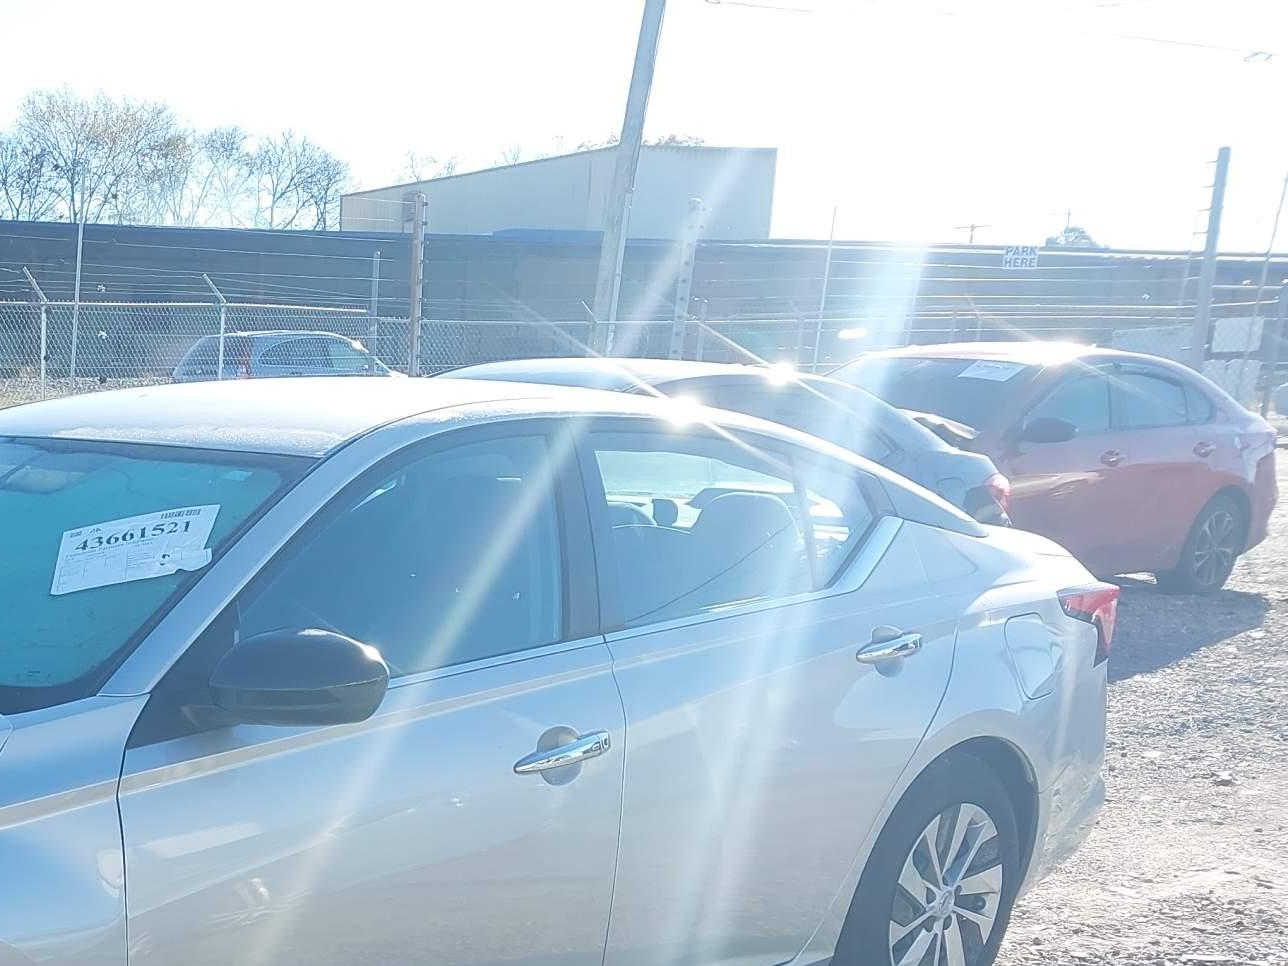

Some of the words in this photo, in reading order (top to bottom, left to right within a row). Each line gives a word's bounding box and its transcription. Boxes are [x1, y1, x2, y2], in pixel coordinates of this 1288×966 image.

[1005, 246, 1038, 256] PARK
[1004, 257, 1037, 268] HERE
[74, 520, 192, 551] 43661521
